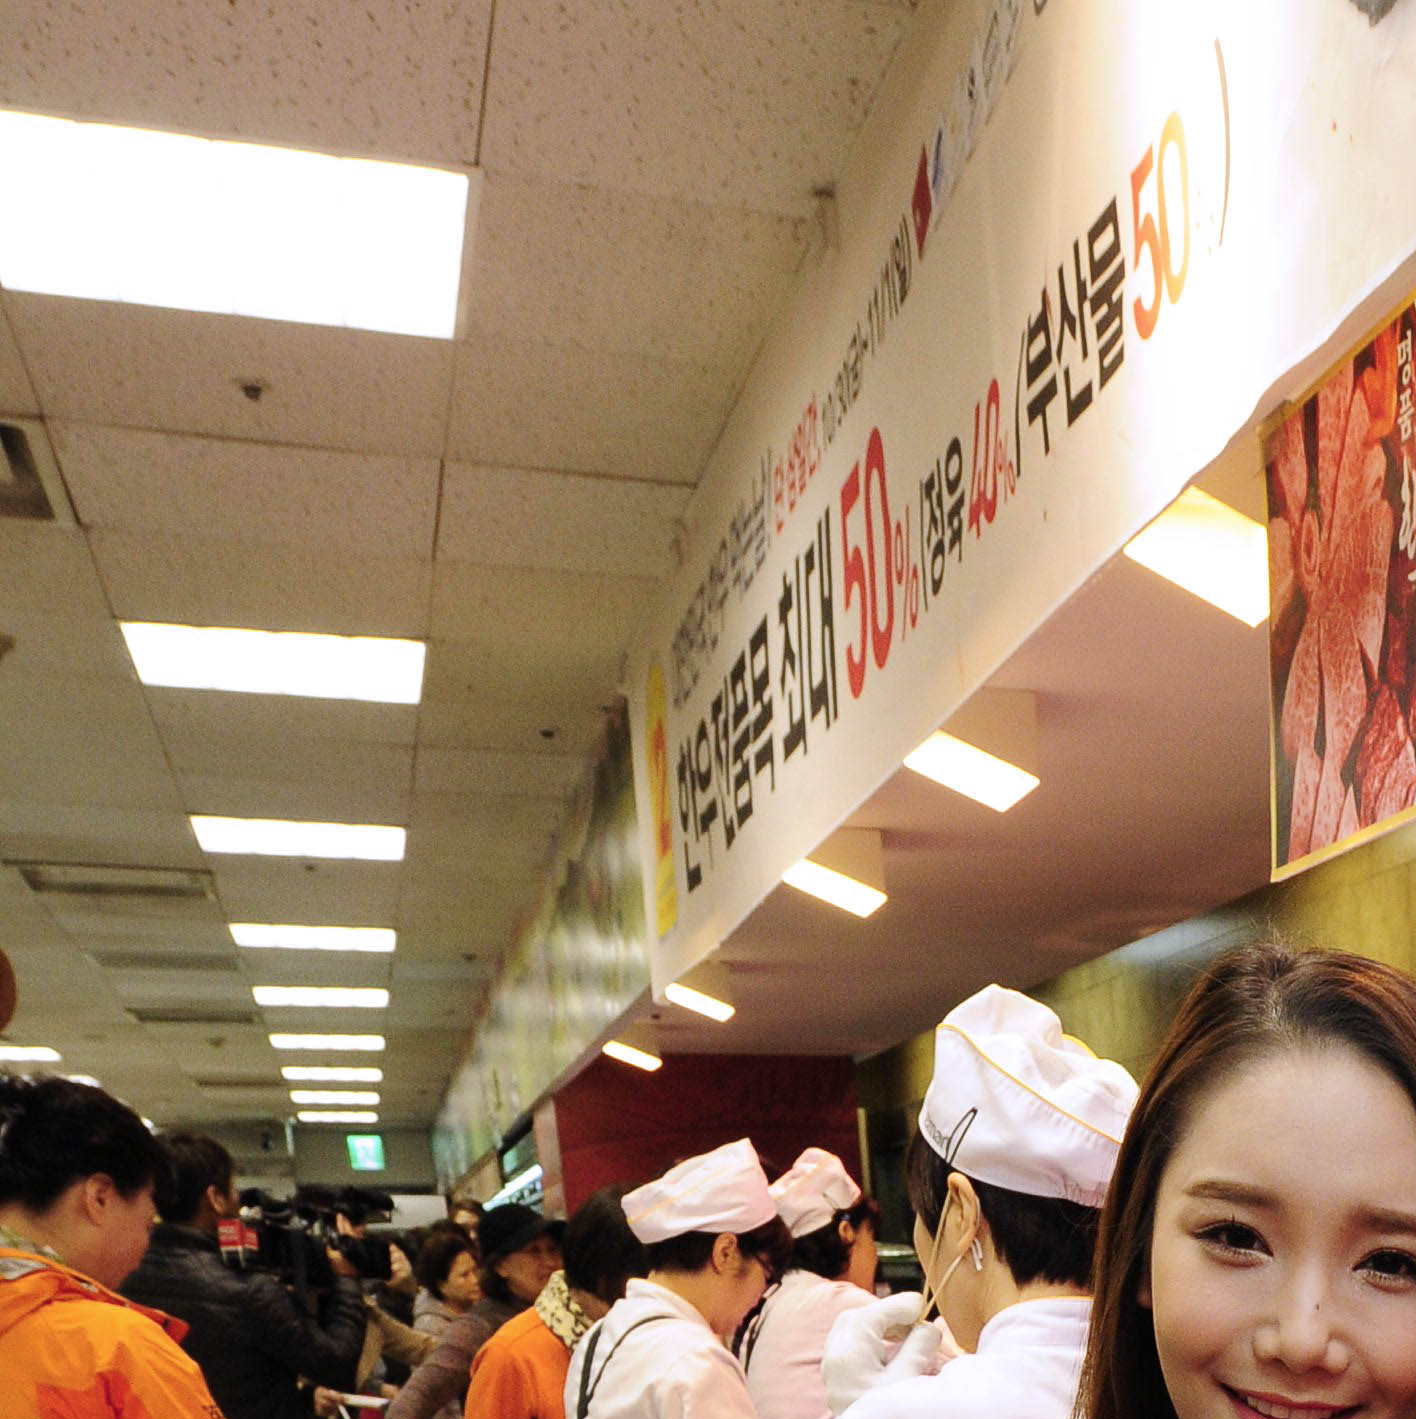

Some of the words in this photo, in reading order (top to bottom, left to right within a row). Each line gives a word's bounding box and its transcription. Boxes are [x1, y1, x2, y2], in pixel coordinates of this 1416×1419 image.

[677, 613, 775, 894] 한우전품목
[779, 504, 838, 755] 최대
[840, 426, 919, 699] 50%
[968, 378, 1017, 540] 40%
